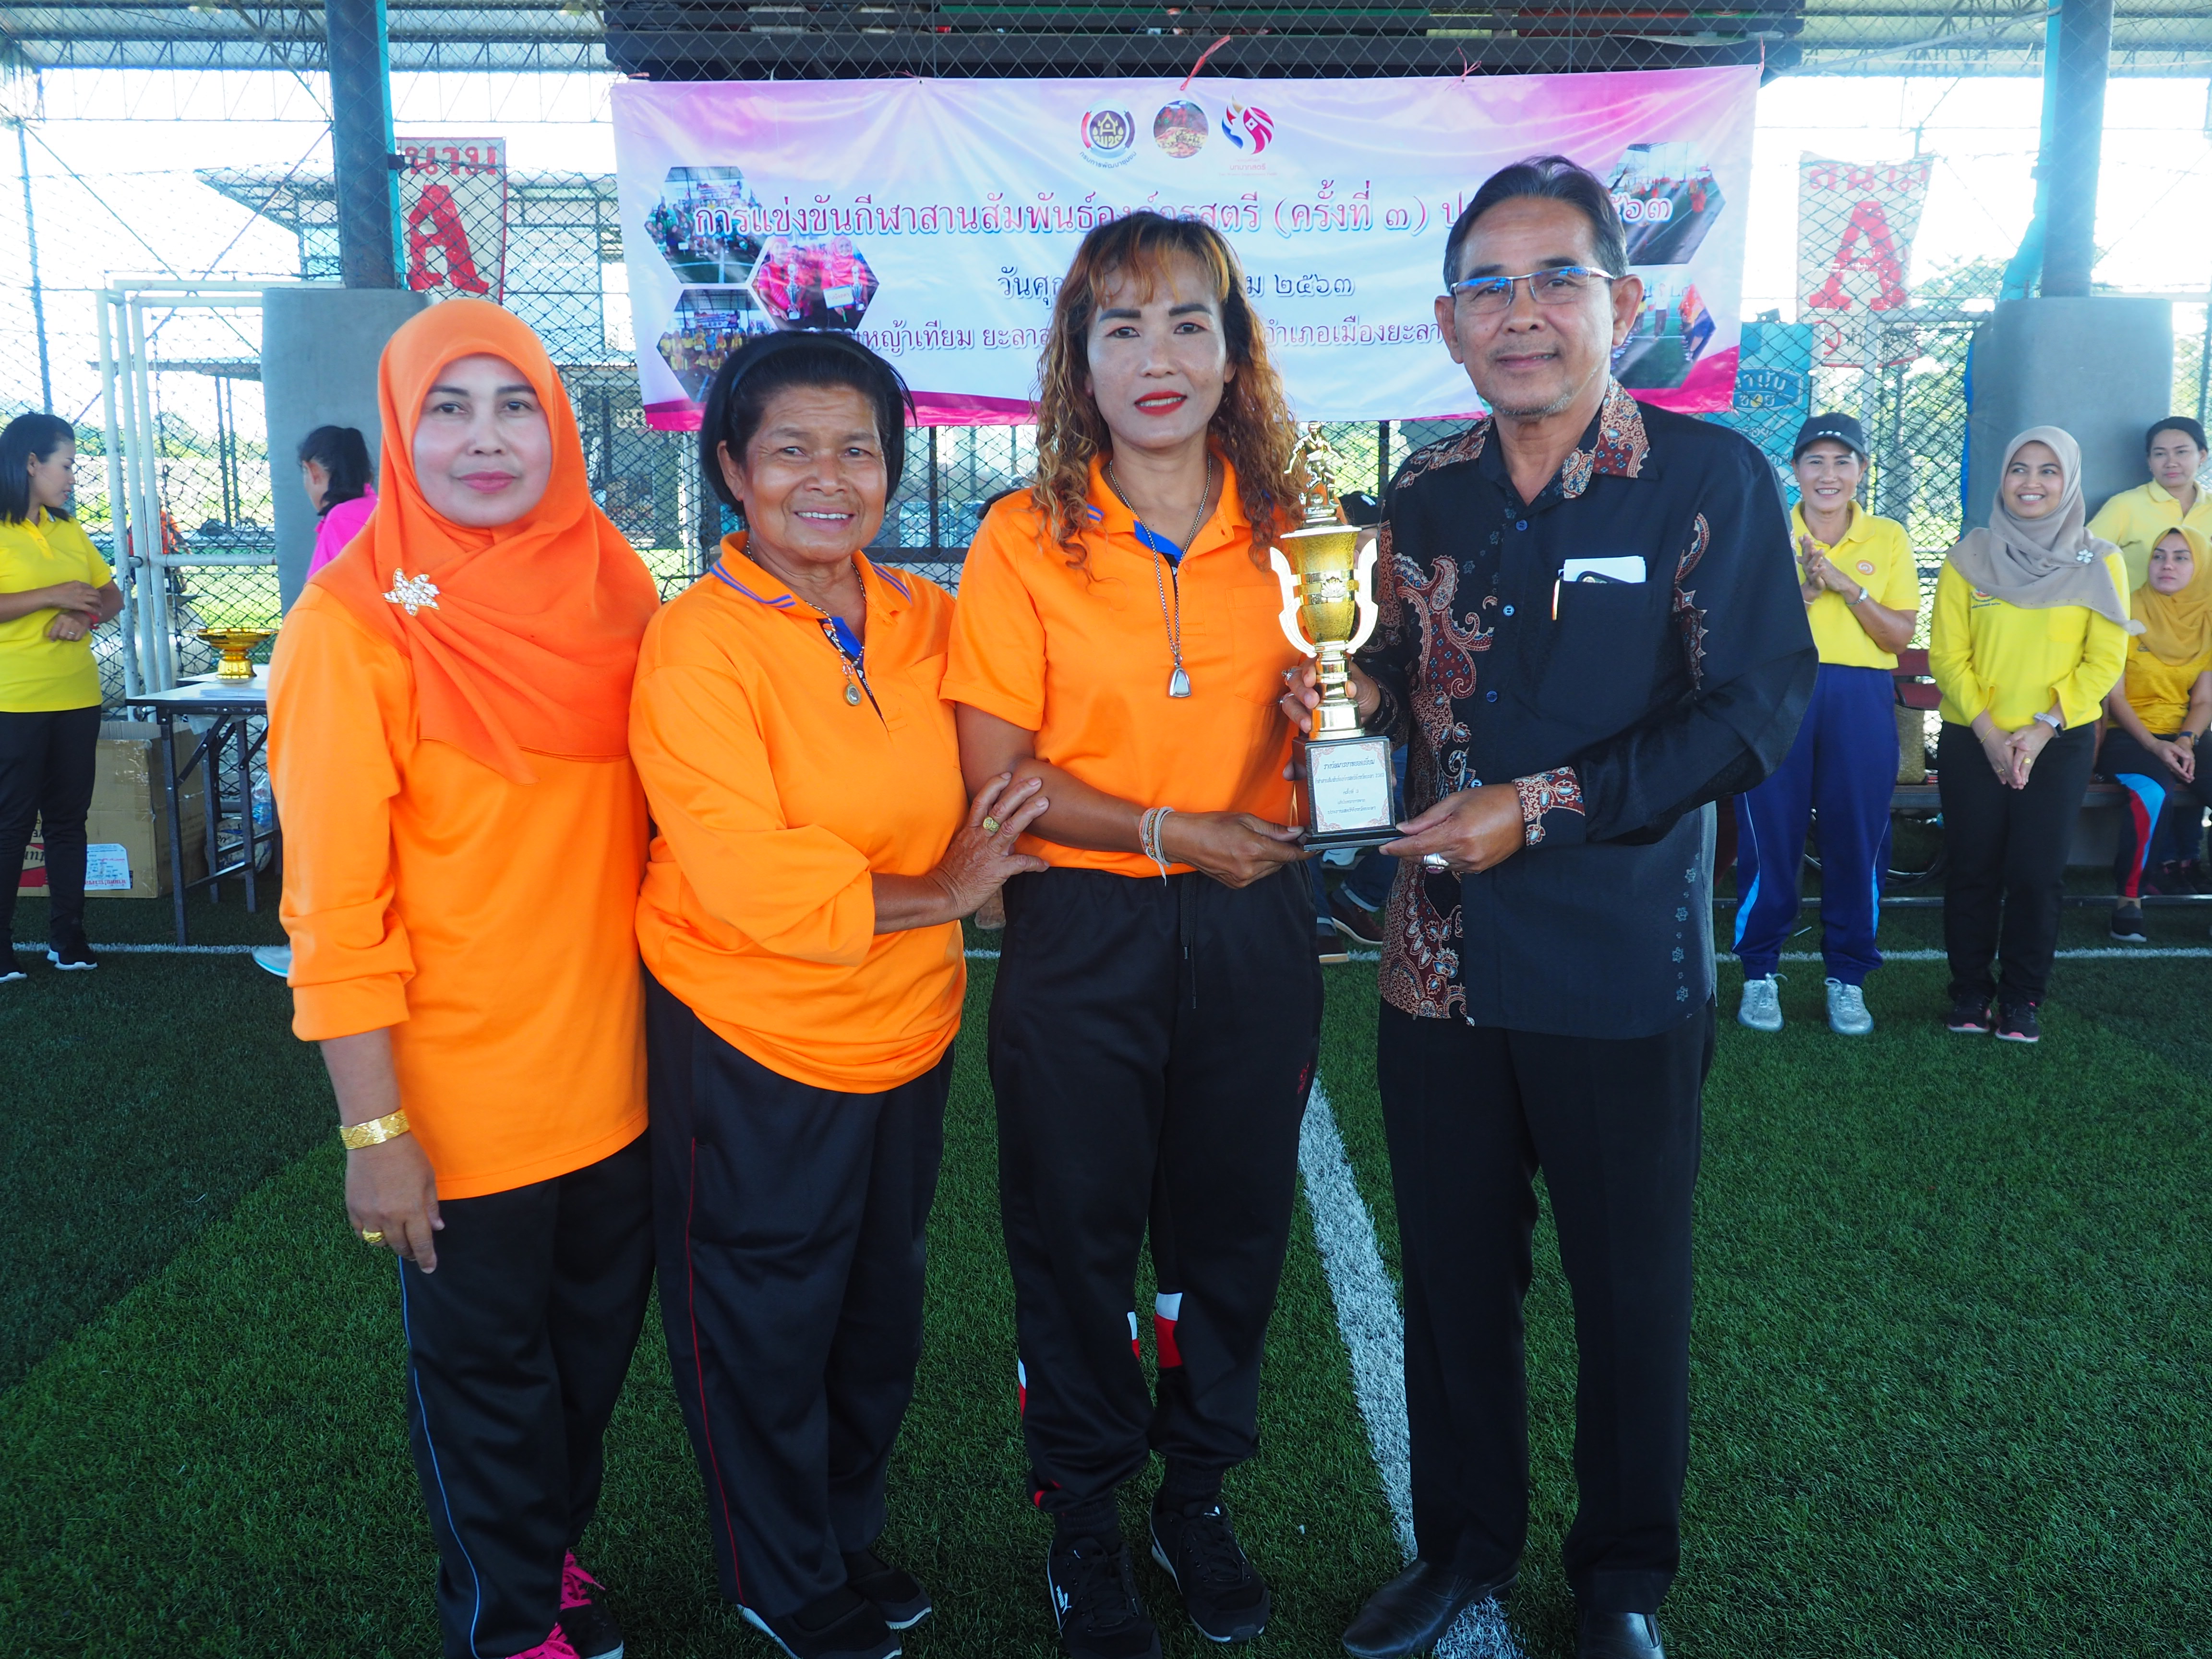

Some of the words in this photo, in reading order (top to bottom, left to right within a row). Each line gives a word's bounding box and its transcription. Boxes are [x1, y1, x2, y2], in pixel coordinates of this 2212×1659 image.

[397, 146, 496, 175] นาม
[1274, 179, 1370, 235] (ครั้งที่
[1385, 195, 1426, 232] ๓)
[407, 185, 489, 294] A
[1809, 201, 1908, 311] A
[998, 266, 1064, 306] วันศุก
[1274, 274, 1352, 294] ๒๕๖๓
